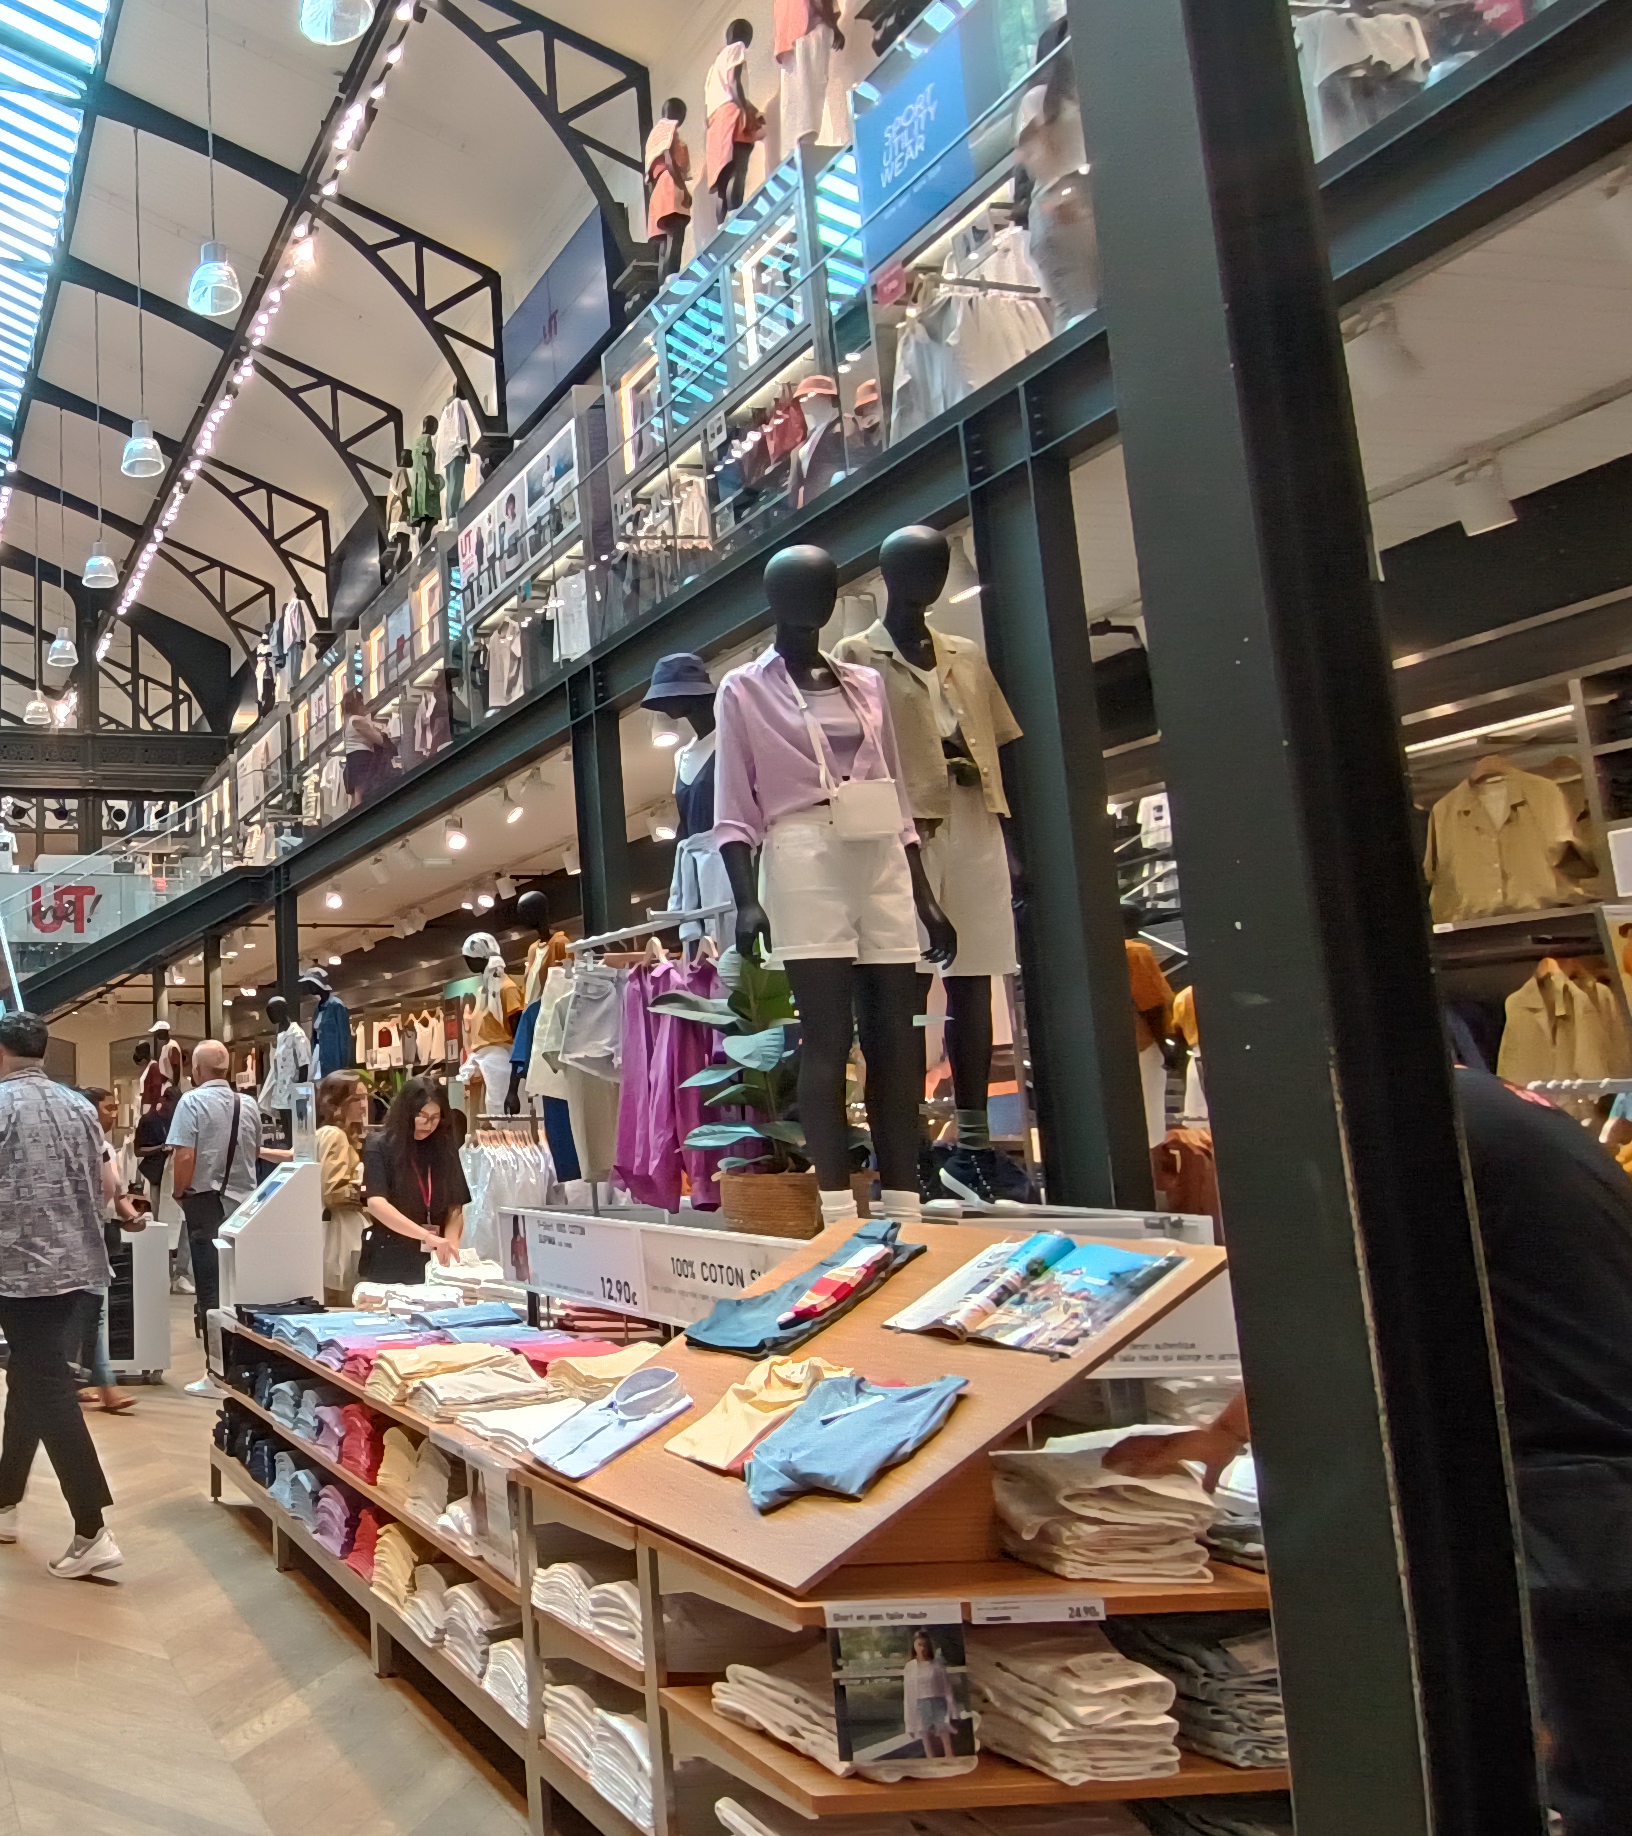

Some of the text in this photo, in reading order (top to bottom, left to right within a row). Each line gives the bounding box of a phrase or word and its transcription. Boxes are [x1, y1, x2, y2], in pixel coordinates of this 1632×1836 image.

[883, 100, 938, 167] UTILITY
[884, 82, 935, 146] SPORT
[881, 135, 925, 188] WEAR
[460, 530, 472, 559] UT
[32, 885, 96, 933] UT
[670, 1256, 696, 1280] 100%
[700, 1261, 745, 1289] COTON
